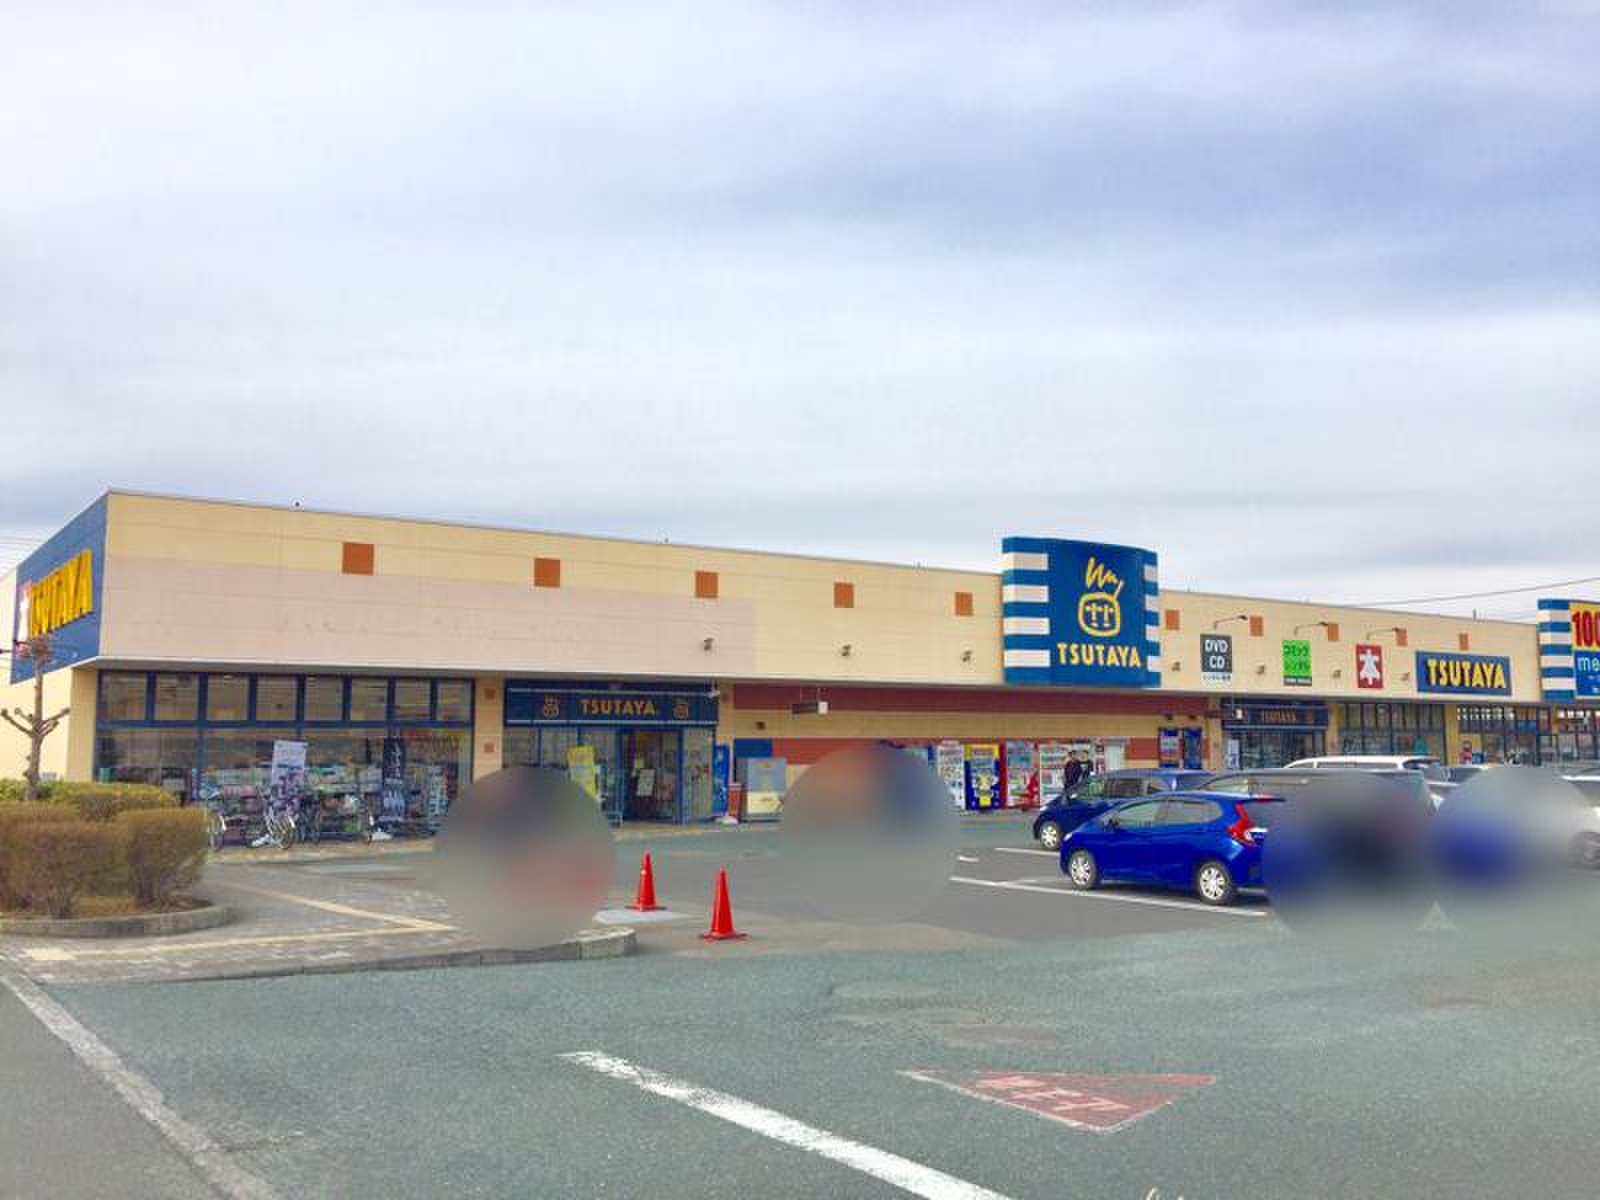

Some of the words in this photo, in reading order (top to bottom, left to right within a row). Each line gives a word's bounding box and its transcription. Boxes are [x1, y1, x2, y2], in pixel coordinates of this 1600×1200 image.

[1056, 642, 1142, 669] TSUTAYA
[1204, 639, 1228, 653] DVD
[1209, 655, 1226, 669] CD
[1359, 648, 1381, 686] 本
[1426, 658, 1507, 689] TSUTAYA
[580, 699, 656, 716] TSUTAYA
